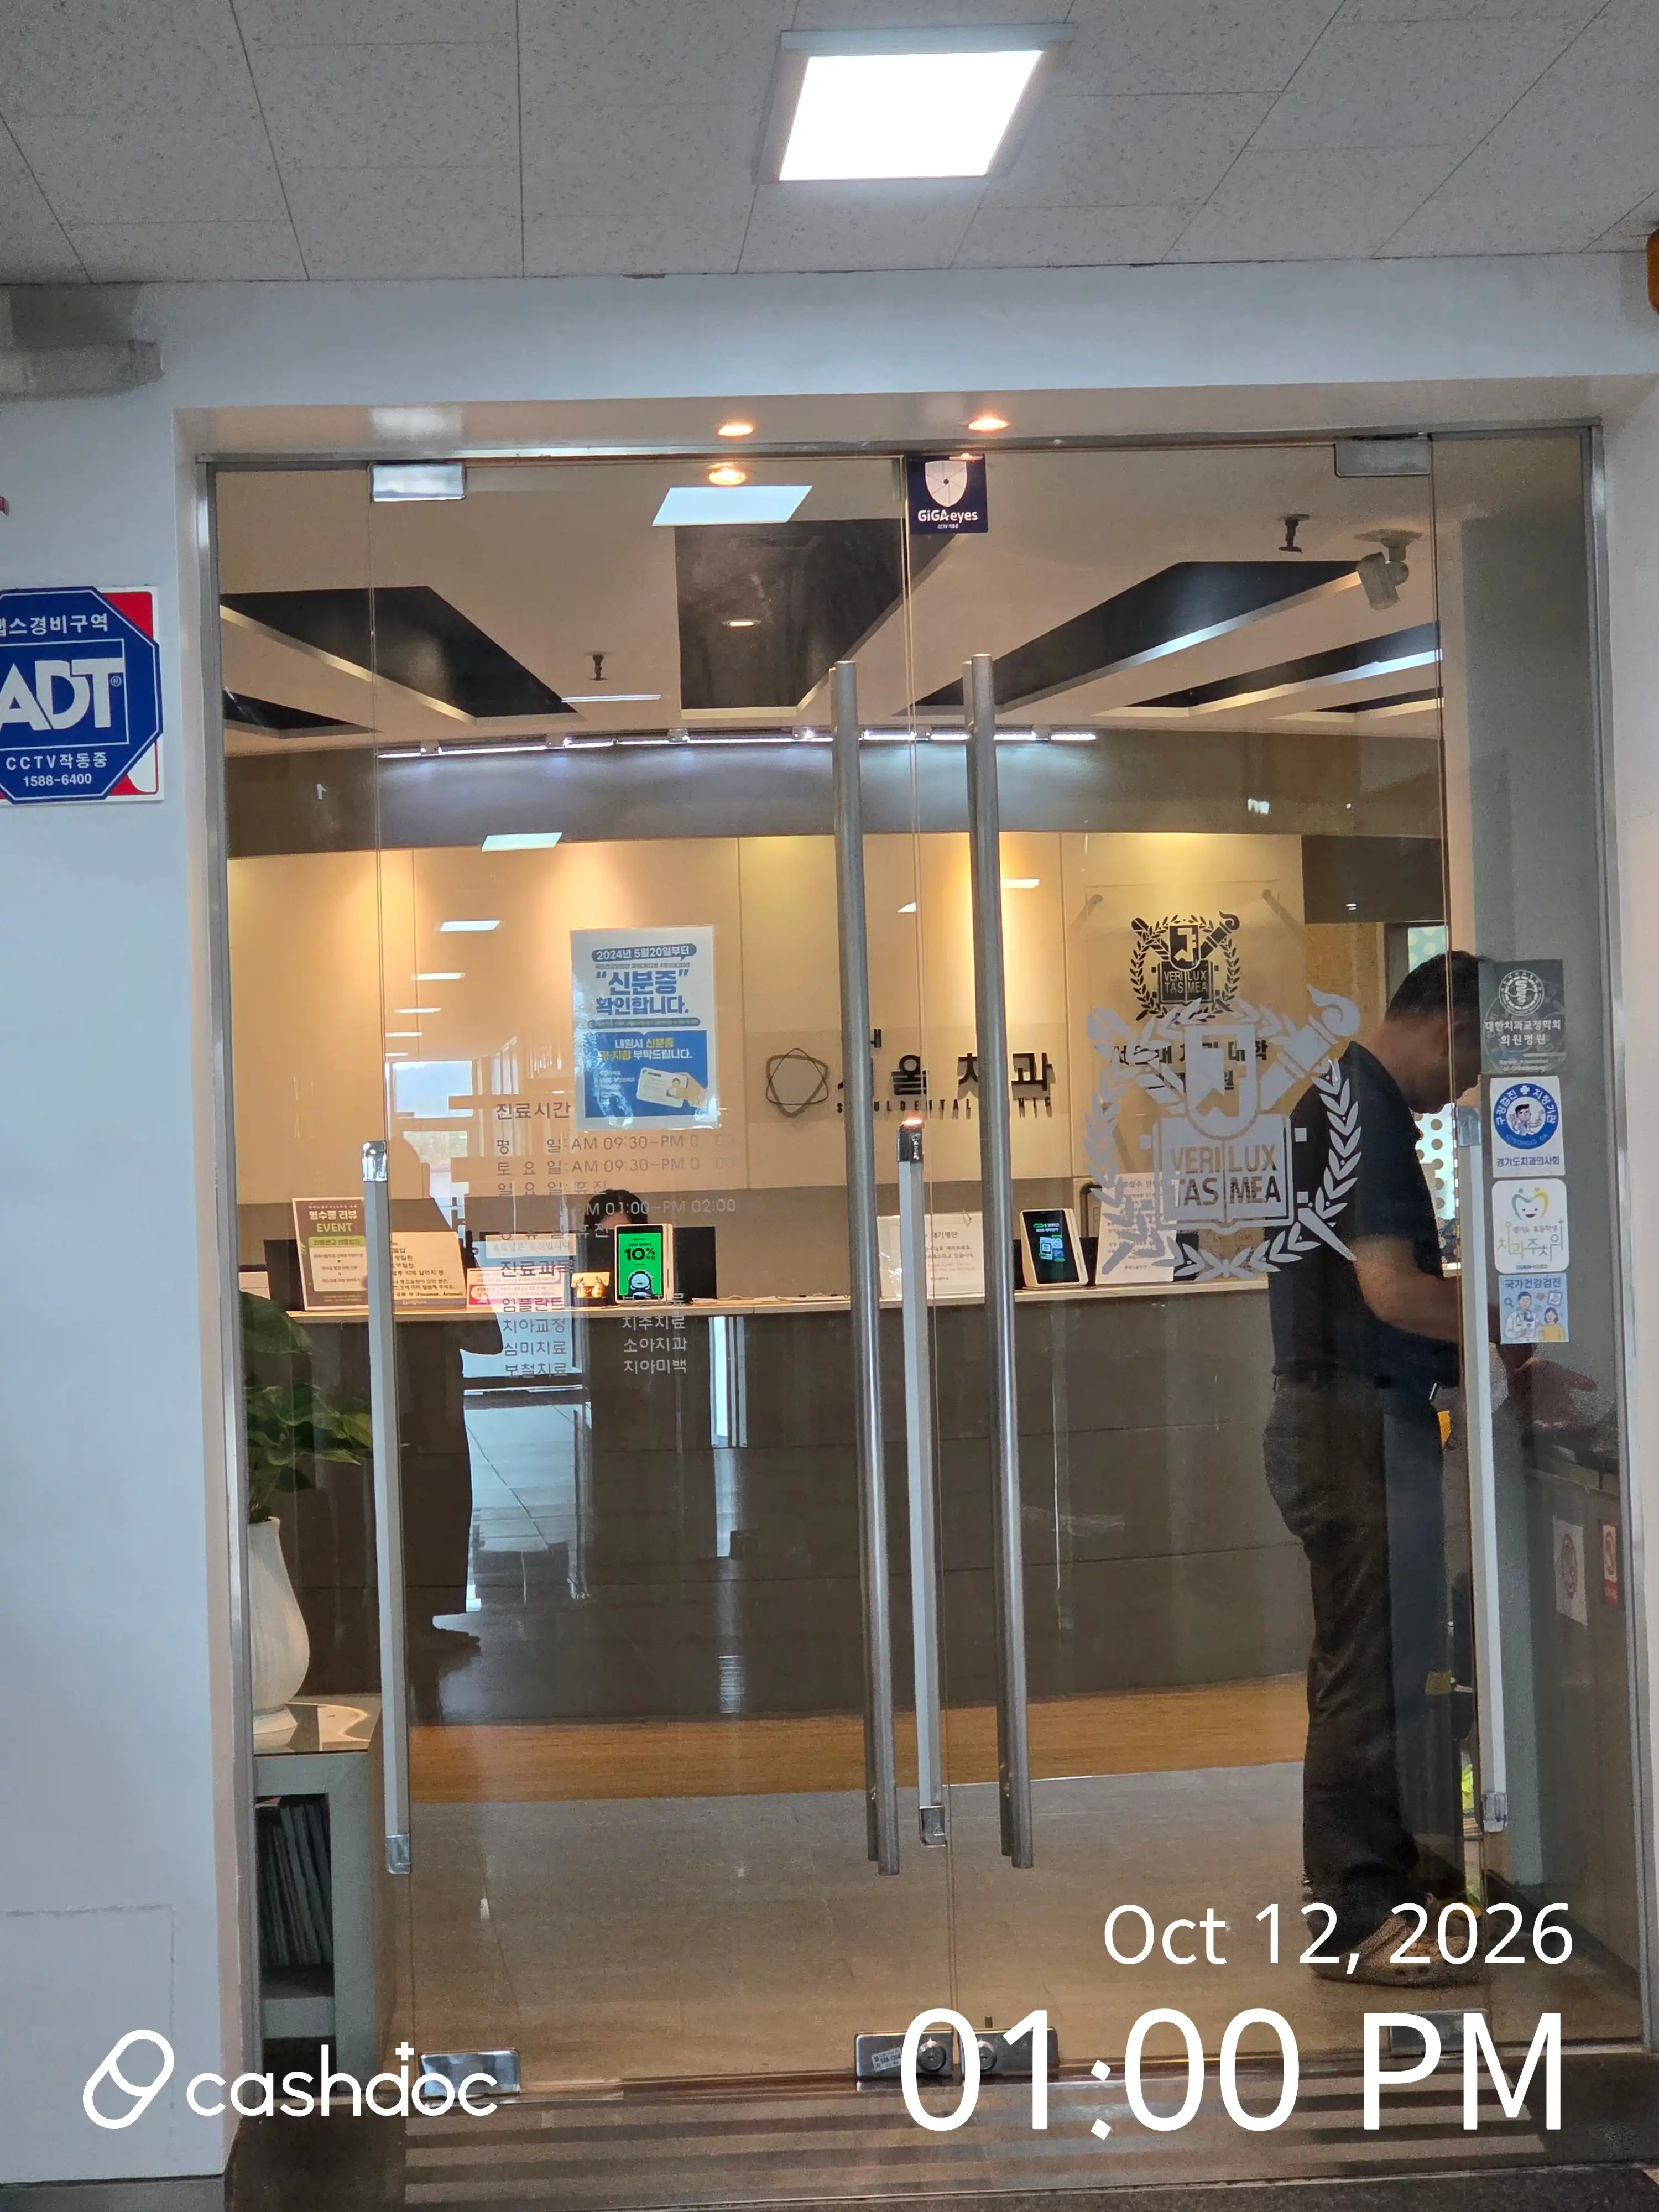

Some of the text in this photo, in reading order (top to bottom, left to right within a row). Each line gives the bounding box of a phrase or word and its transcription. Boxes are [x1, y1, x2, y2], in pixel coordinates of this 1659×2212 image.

[0, 658, 125, 731] ADT
[6, 752, 107, 770] CCTV작동중
[23, 773, 92, 787] 1588-6400
[597, 945, 690, 961] 2024년 5월20일부터
[1164, 971, 1207, 982] VERI LUX
[1164, 982, 1208, 994] TAS MEA
[596, 995, 690, 1016] 확인합니다.
[1484, 1019, 1561, 1031] 대한치과교정학회
[1500, 1033, 1546, 1046] 회원병원
[495, 1102, 572, 1120] 진료시간
[571, 1136, 598, 1151] AM
[1170, 1144, 1277, 1173] VERI LUX
[1496, 1156, 1560, 1167] 경기도치과의사회
[572, 1160, 598, 1173] AM
[1171, 1175, 1281, 1207] TAS MEA
[691, 1199, 736, 1213] 02:00
[316, 1223, 353, 1233] EVENT
[624, 1247, 656, 1261] 10%
[1505, 1277, 1562, 1289] 국가건강검진
[502, 1297, 565, 1312] 임플란트
[503, 1318, 566, 1333] 치아교정
[622, 1314, 686, 1331] 치주치료
[504, 1340, 567, 1356] 심미치료
[623, 1337, 687, 1353] 소아치과
[505, 1362, 568, 1378] 보철치료
[623, 1359, 687, 1374] 치아미백
